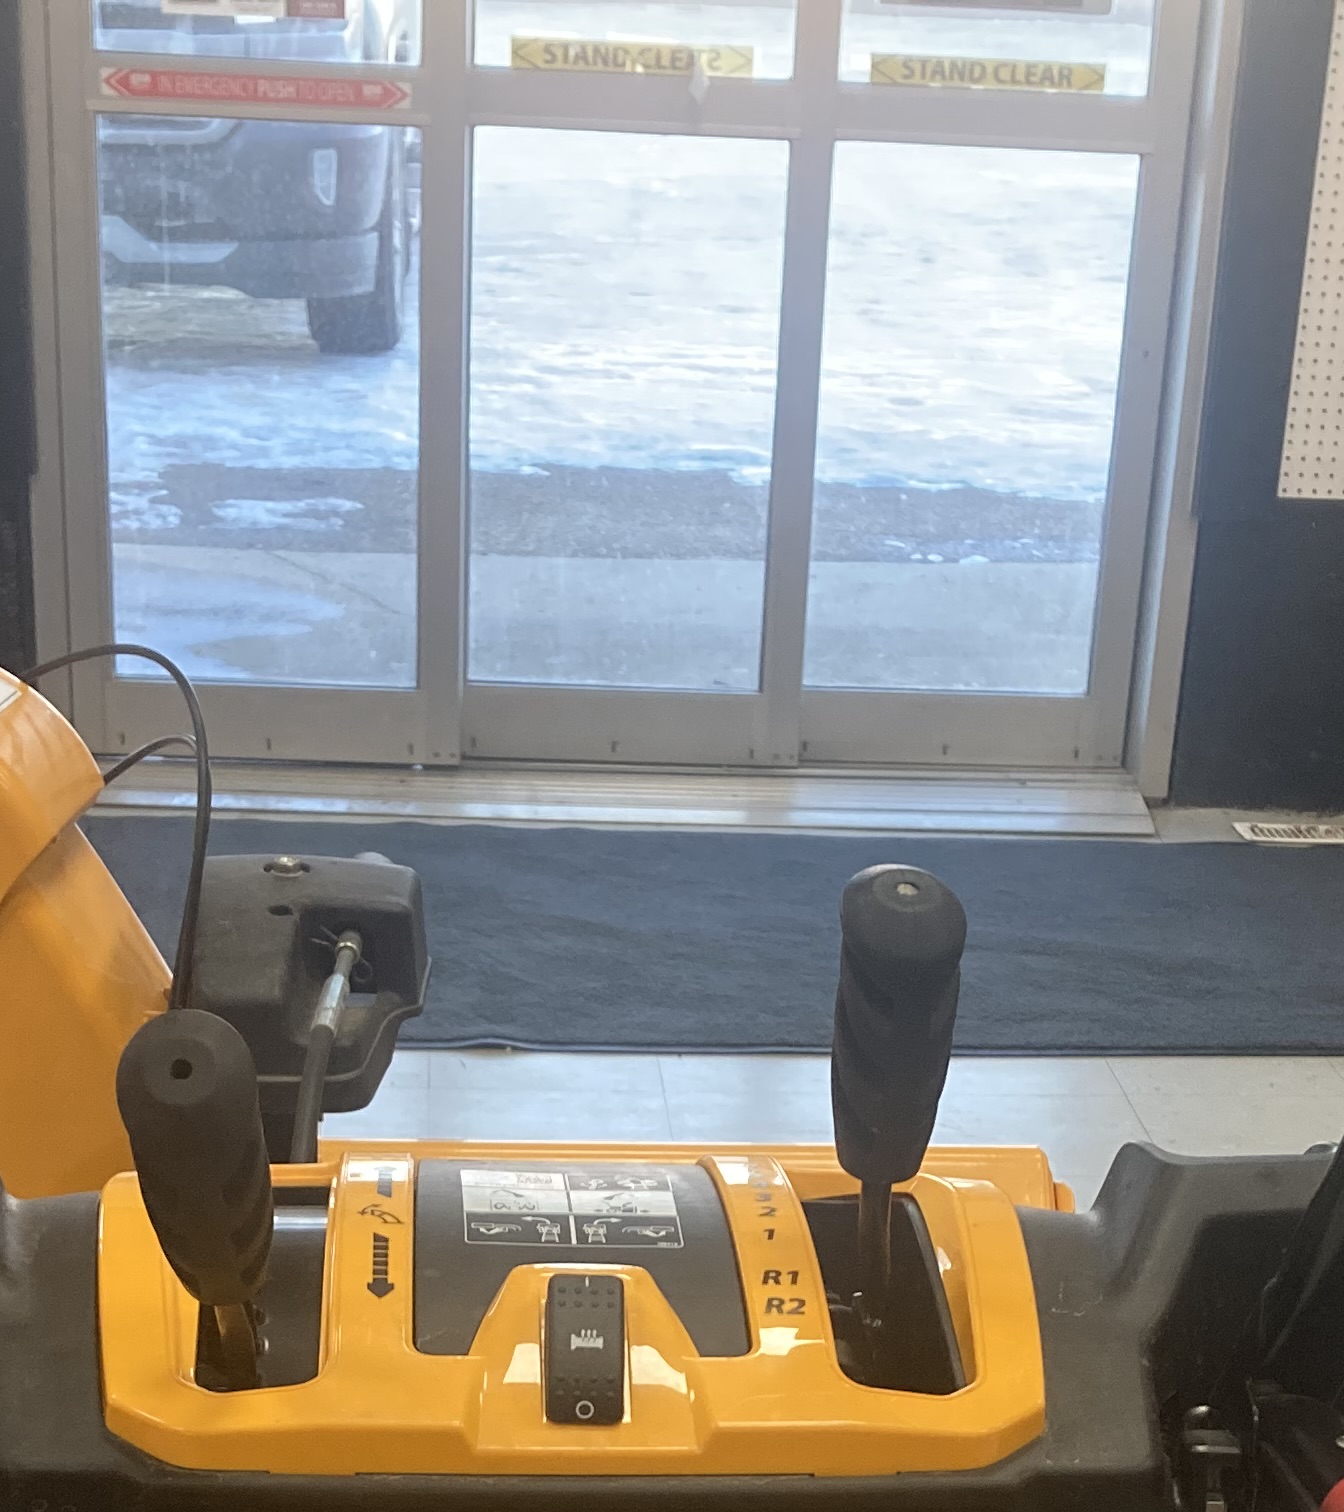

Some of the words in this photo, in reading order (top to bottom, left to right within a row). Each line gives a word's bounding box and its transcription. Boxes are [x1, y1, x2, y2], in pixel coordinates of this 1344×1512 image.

[542, 42, 627, 68] STAND
[899, 58, 987, 84] STAND
[993, 62, 1074, 88] CLEAR
[257, 79, 297, 99] PUSH
[758, 1205, 778, 1217] 2
[763, 1228, 776, 1241] 1
[761, 1269, 800, 1286] R1
[764, 1297, 807, 1316] R2
